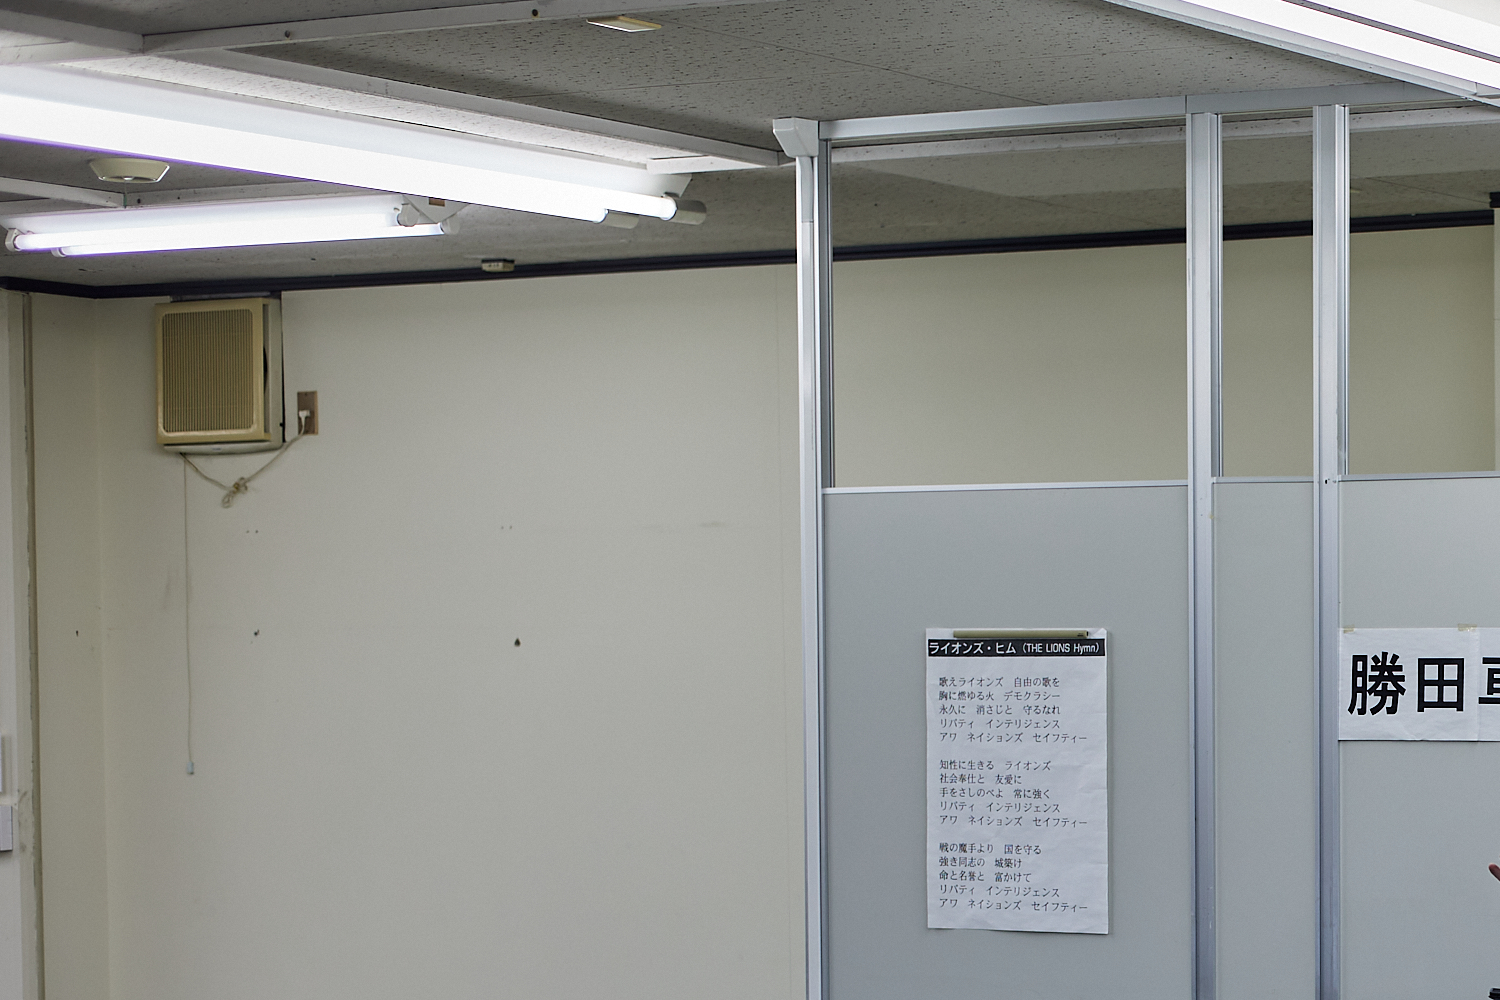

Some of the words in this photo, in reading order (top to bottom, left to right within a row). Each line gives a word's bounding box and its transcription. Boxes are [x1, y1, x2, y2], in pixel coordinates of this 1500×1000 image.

[928, 641, 1017, 655] ライオンズ・ヒム
[1045, 643, 1071, 654] LIONS
[939, 676, 1003, 688] 歌えライオンズ
[1014, 677, 1060, 688] 自由の歌を
[939, 690, 994, 702] 胸に燃ゆる火
[1003, 690, 1061, 702] デモクラシー
[939, 704, 966, 715] 永久に
[976, 704, 1013, 716] 消さじと
[1023, 705, 1061, 716] 守るなれ
[940, 719, 974, 729] リバティ
[986, 719, 1060, 730] インテリジェンス
[940, 732, 957, 742] アワ
[967, 732, 1023, 743] ネイションズ
[1033, 733, 1088, 744] セイフティー
[940, 759, 995, 771] 知性に生きる
[1005, 761, 1052, 772] ライオンズ
[940, 773, 985, 784] 社会奉仕と
[995, 774, 1022, 785] 友愛に
[940, 787, 1003, 798] 手をさしのべよ
[1013, 788, 1050, 799] 常に強く
[940, 801, 974, 812] リバティ
[986, 802, 1060, 813] インテリジェンス
[940, 815, 958, 825] アワ
[969, 815, 1022, 826] ネイションズ
[1033, 817, 1088, 828] セイフティー
[939, 842, 994, 854] 戦の魔手より
[1004, 844, 1042, 855] 国を守る
[939, 856, 985, 867] 強き同志の
[994, 858, 1022, 869] 城築け
[939, 870, 985, 881] 命と名誉と
[994, 872, 1032, 883] 富かけて
[940, 884, 974, 895] リバティ
[986, 886, 1060, 898] インテリジェンス
[940, 898, 958, 908] アワ
[968, 899, 1022, 910] ネイションズ
[1031, 901, 1088, 912] セイフティー
